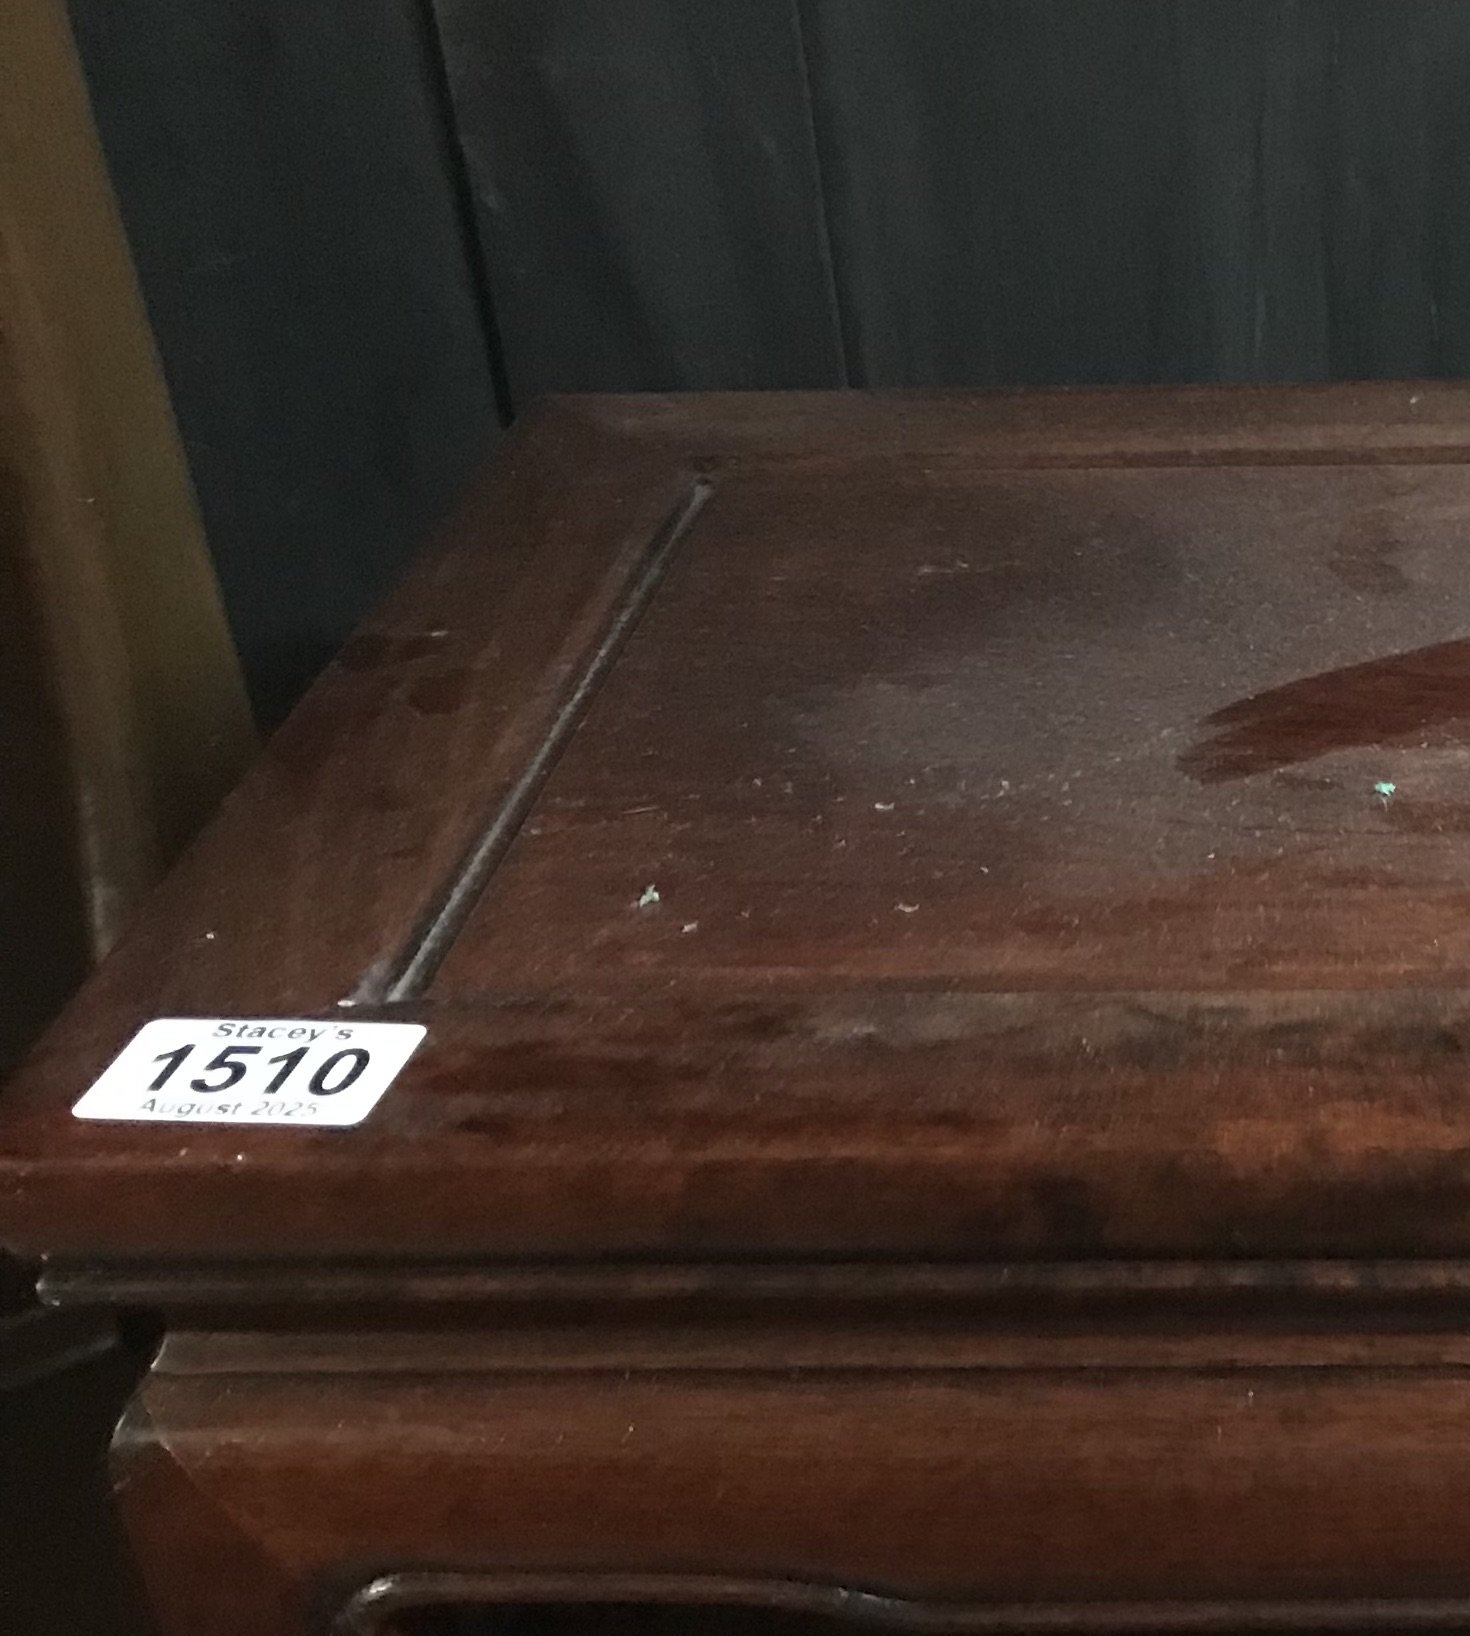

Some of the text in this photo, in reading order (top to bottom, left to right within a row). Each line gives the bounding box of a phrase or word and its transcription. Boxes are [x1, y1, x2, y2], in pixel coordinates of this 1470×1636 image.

[212, 1022, 354, 1042] Stacey's
[147, 1043, 371, 1097] 1510
[140, 1098, 318, 1118] August 2025
